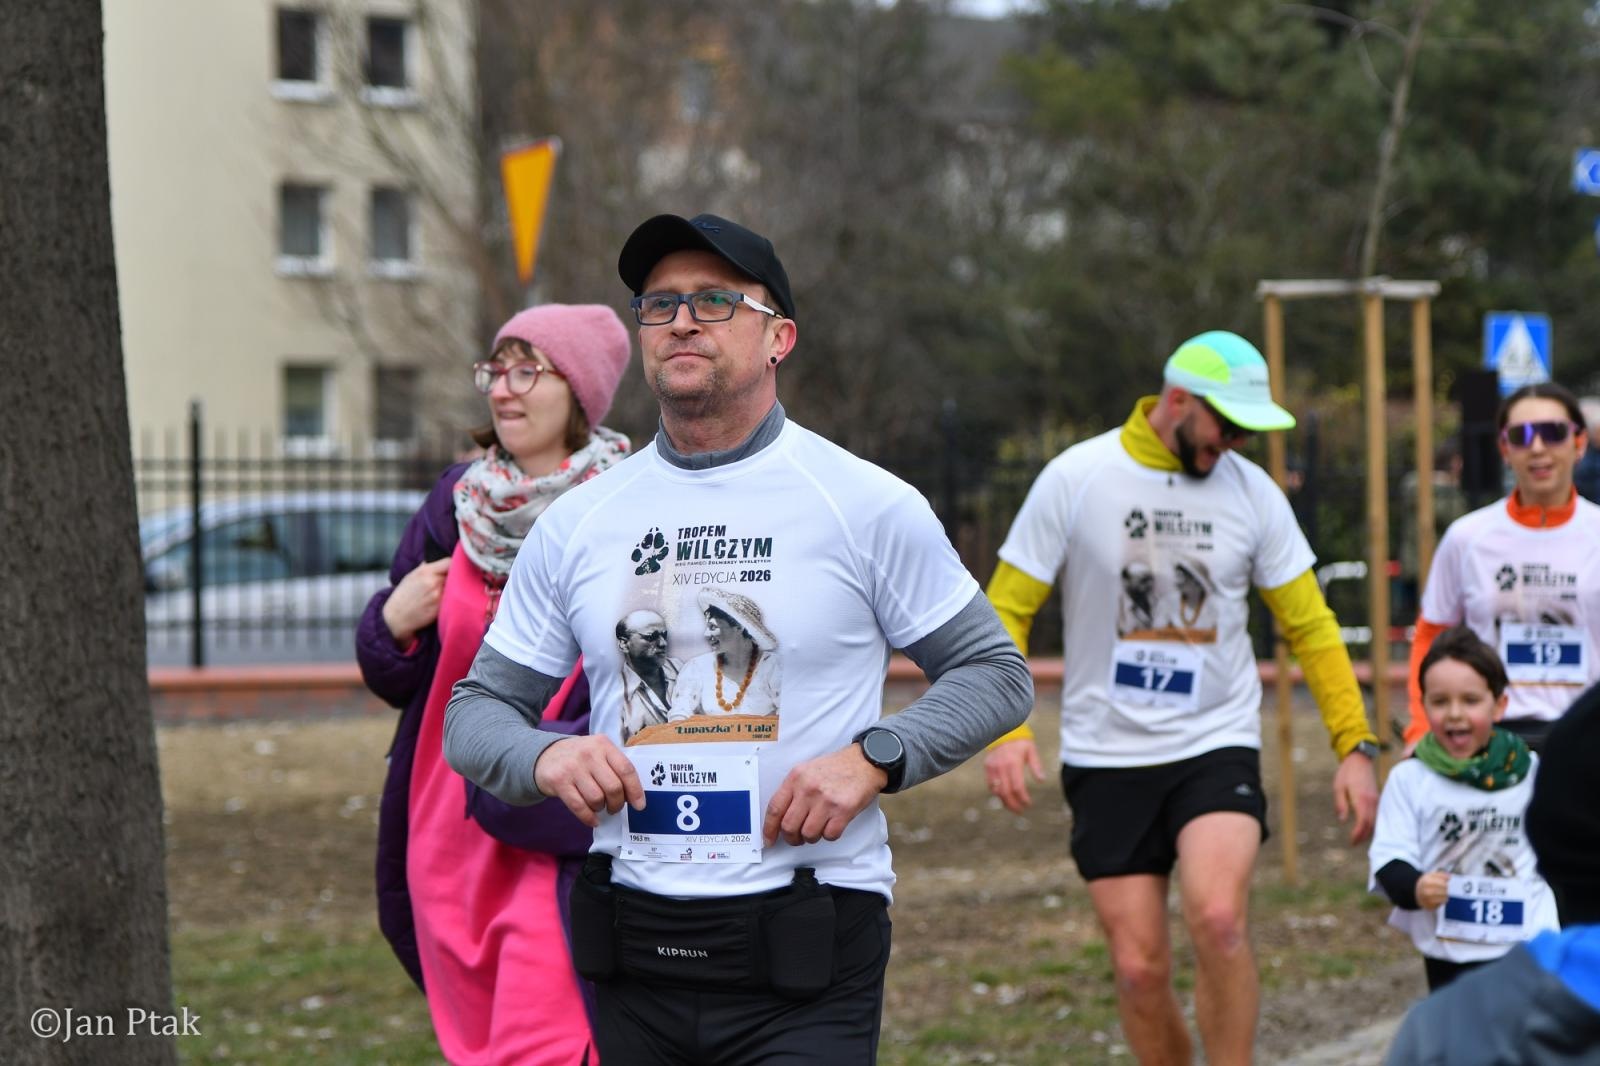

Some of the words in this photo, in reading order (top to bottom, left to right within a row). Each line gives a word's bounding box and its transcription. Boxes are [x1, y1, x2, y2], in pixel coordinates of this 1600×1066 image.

[678, 525, 726, 540] TROPEM
[676, 537, 773, 561] WILCZYM
[673, 573, 692, 586] XIV
[694, 571, 737, 585] EDYCJA
[740, 569, 771, 582] 2026
[1530, 642, 1561, 665] 19
[1141, 667, 1174, 692] 17
[670, 763, 694, 771] TROPEM
[671, 772, 717, 784] WILCZYM
[676, 794, 701, 832] 8
[629, 834, 644, 842] 1963
[1470, 900, 1504, 924] 18
[657, 946, 709, 958] KIPRUN
